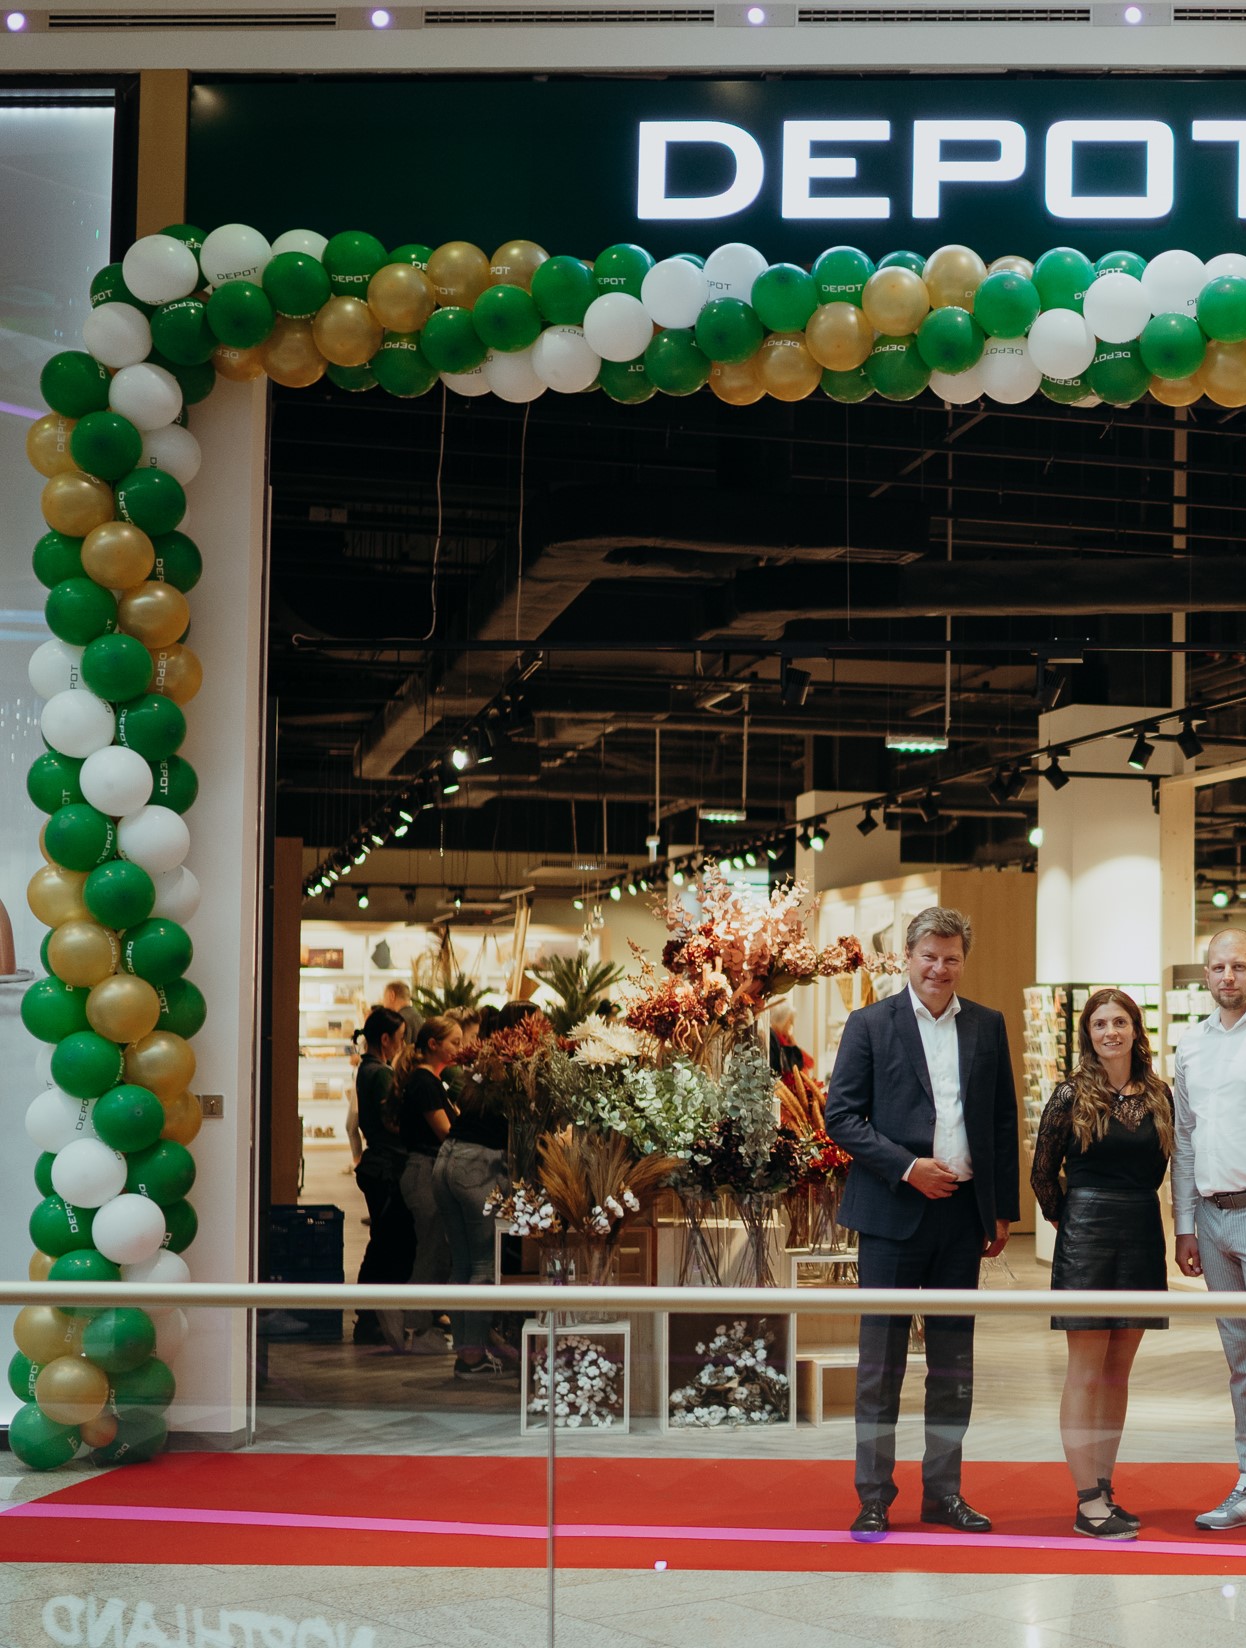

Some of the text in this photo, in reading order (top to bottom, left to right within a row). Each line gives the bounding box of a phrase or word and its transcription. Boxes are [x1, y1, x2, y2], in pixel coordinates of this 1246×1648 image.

[217, 267, 258, 280] DEPOT
[490, 266, 511, 275] POT
[332, 274, 371, 283] DEPOT
[598, 277, 626, 285] EPOT
[708, 280, 731, 290] POT
[822, 284, 862, 293] DEPOT
[92, 290, 112, 303] POT
[163, 302, 202, 312] DEPOT
[560, 328, 585, 338] POT
[217, 349, 238, 359] DEP
[872, 345, 906, 355] DEPOT
[985, 348, 1023, 356] DEPOT
[1094, 351, 1130, 363] DEPOT
[156, 558, 164, 583] DEP
[70, 664, 78, 689] POT
[156, 652, 167, 693] DEPOT
[126, 941, 134, 973] DEPO
[75, 1099, 90, 1130] DEPO
[64, 1201, 78, 1233] DEPO
[28, 1364, 38, 1397] DEPO
